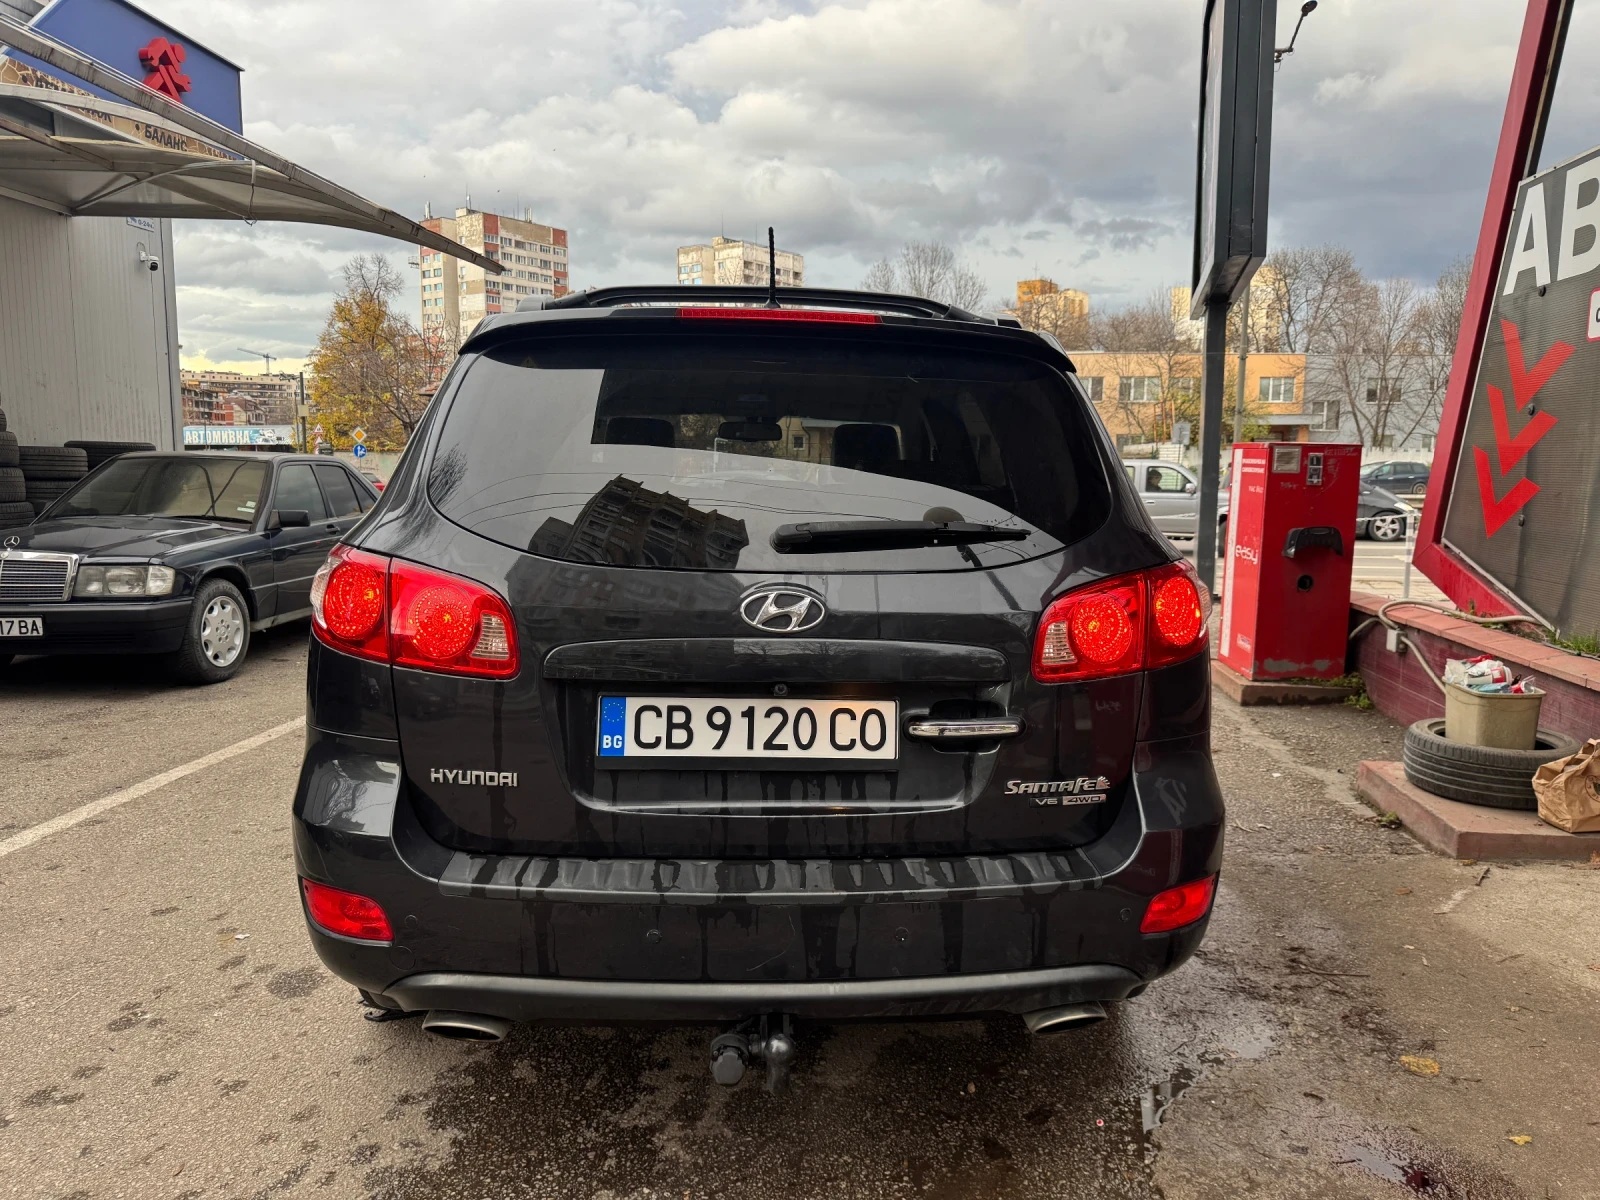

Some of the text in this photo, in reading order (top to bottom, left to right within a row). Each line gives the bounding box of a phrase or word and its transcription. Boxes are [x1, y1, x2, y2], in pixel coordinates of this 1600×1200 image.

[144, 123, 188, 152] БАЛАНС
[185, 430, 249, 444] АВТОМИВКА
[1235, 545, 1259, 565] easy
[18, 620, 40, 635] BA
[633, 704, 887, 752] CB 9120 CO
[602, 734, 623, 749] BG
[430, 768, 518, 787] HYUNDAI
[1035, 795, 1102, 806] V6 4WD
